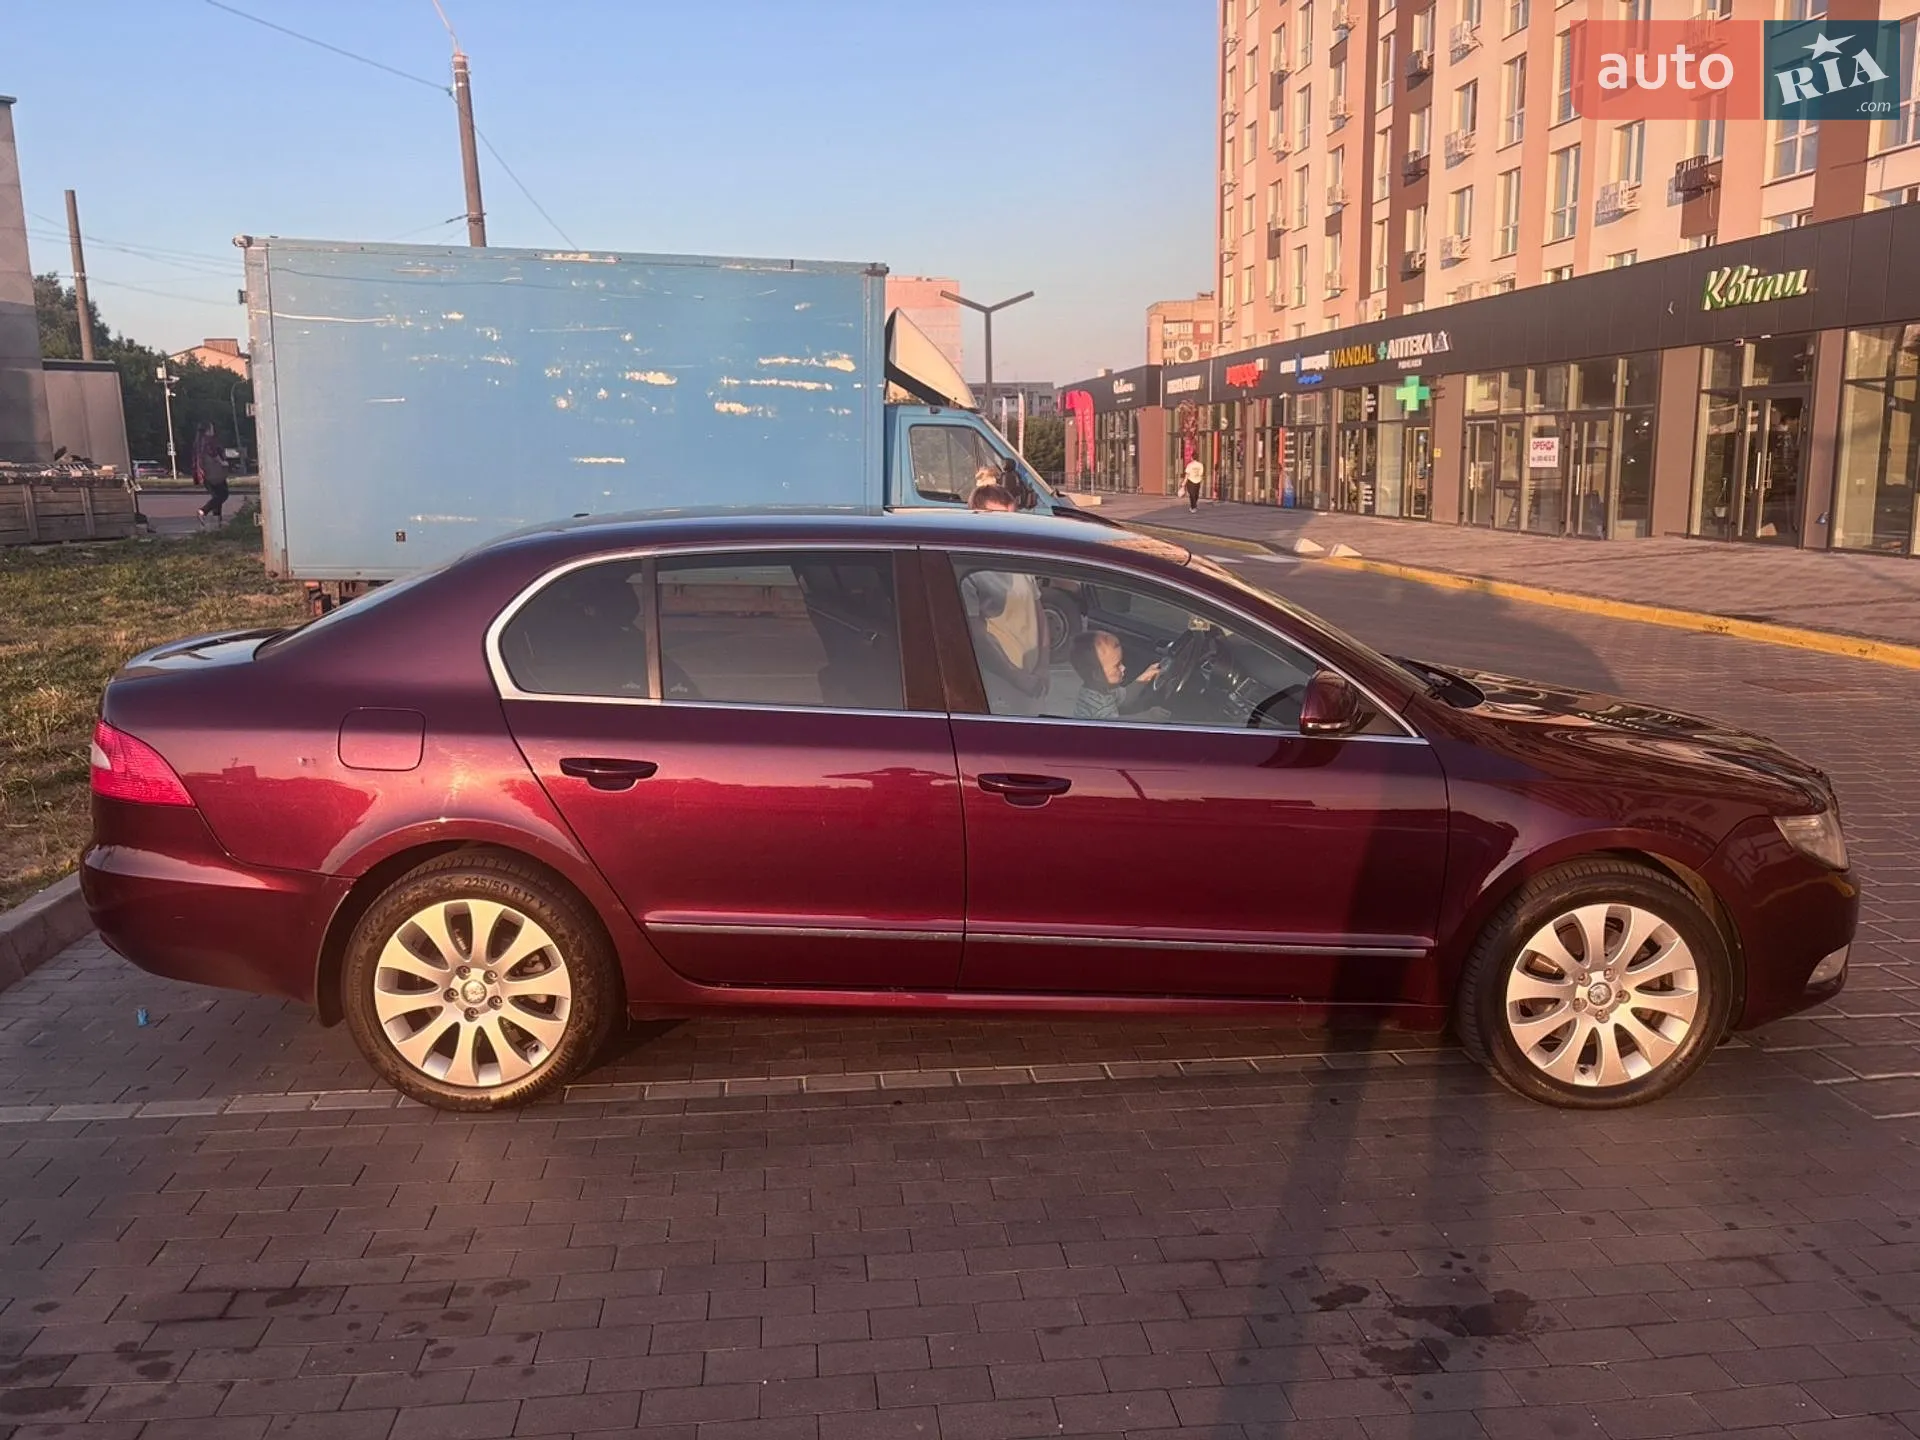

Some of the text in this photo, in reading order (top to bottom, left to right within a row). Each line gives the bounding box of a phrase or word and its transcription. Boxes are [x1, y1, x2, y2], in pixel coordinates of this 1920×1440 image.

[1333, 343, 1376, 369] VANDAL
[1387, 332, 1434, 360] АПТЕКА
[463, 877, 509, 894] 225/50
[511, 887, 521, 899] R
[522, 892, 535, 903] 17
